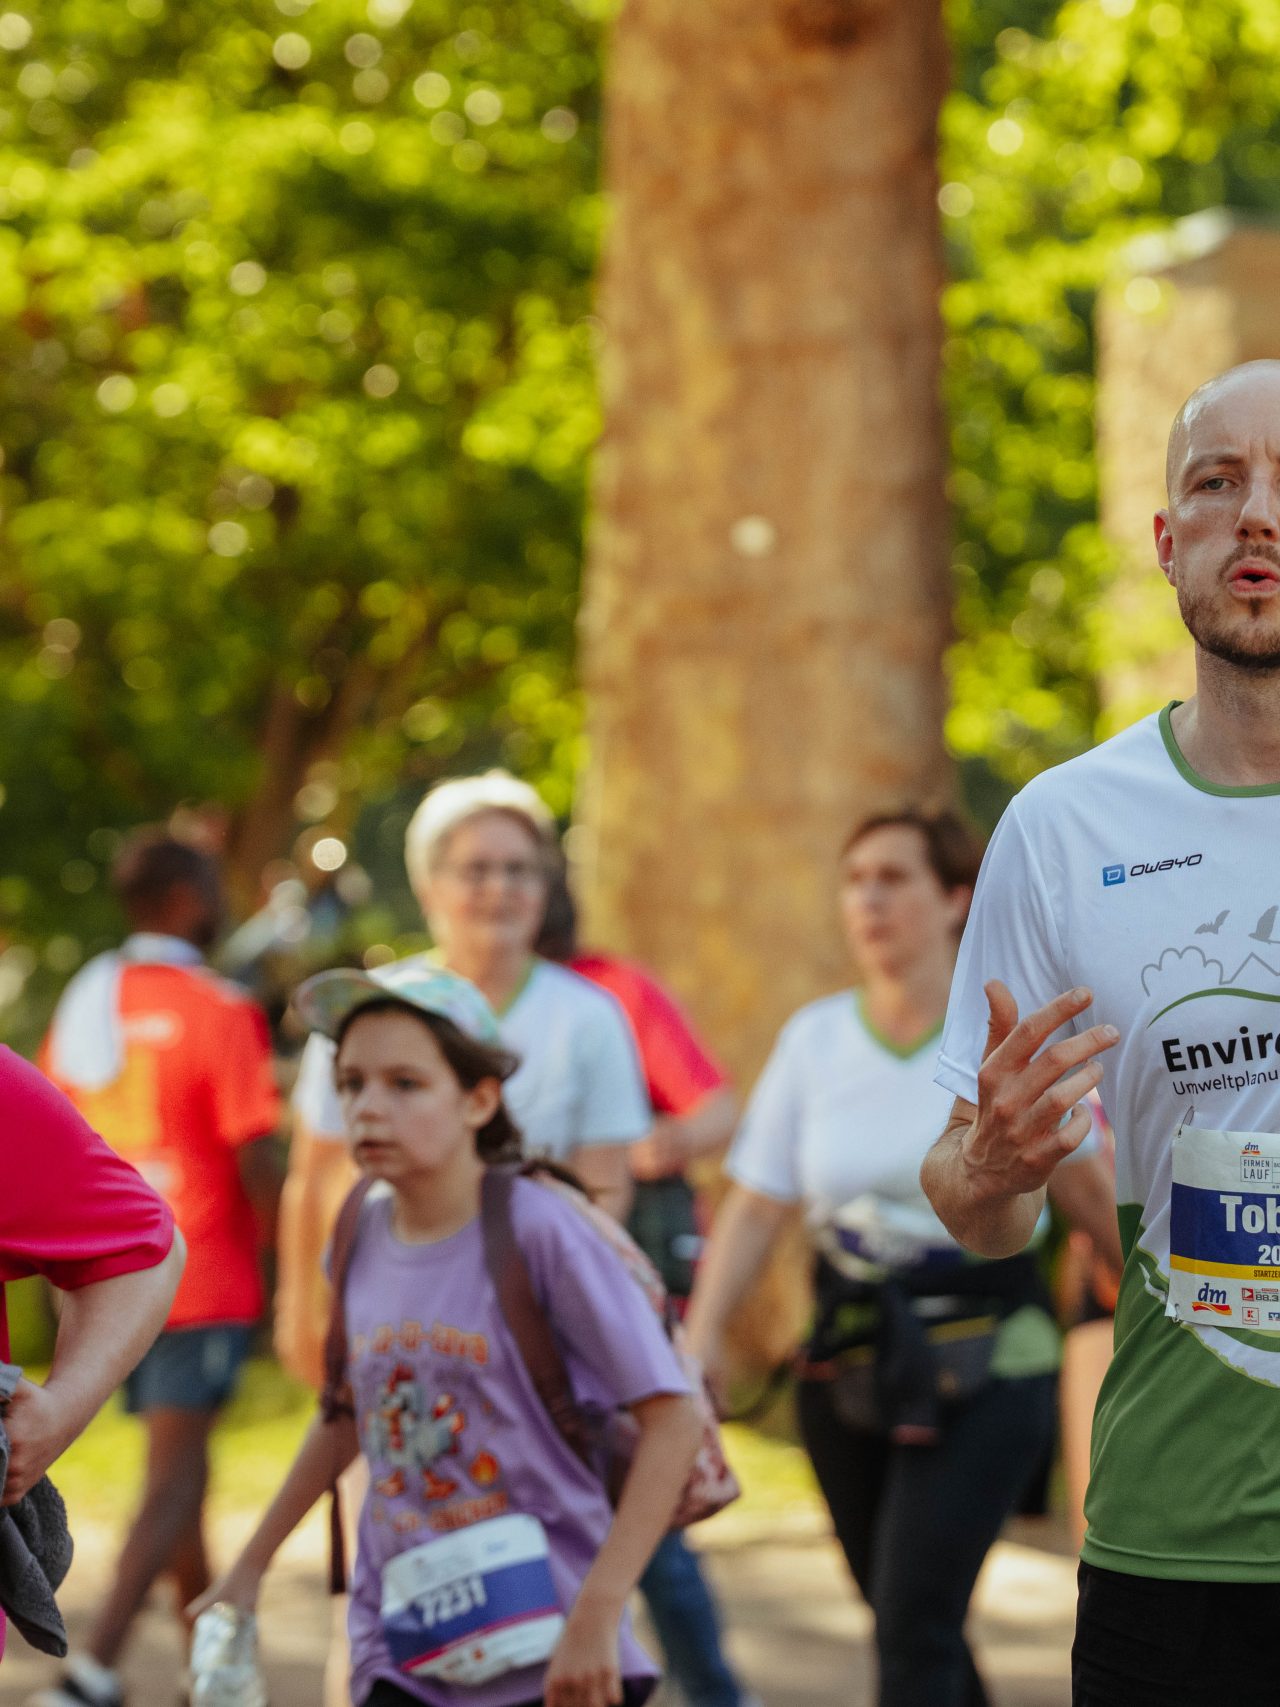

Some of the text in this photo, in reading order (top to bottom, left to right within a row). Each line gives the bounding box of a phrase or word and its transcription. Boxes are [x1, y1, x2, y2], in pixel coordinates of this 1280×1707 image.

[1244, 1142, 1259, 1151] dm
[1243, 1159, 1270, 1168] FIRMEN
[1243, 1168, 1270, 1180] LAUF
[1198, 1282, 1227, 1305] dm
[1255, 1293, 1279, 1302] 88.3
